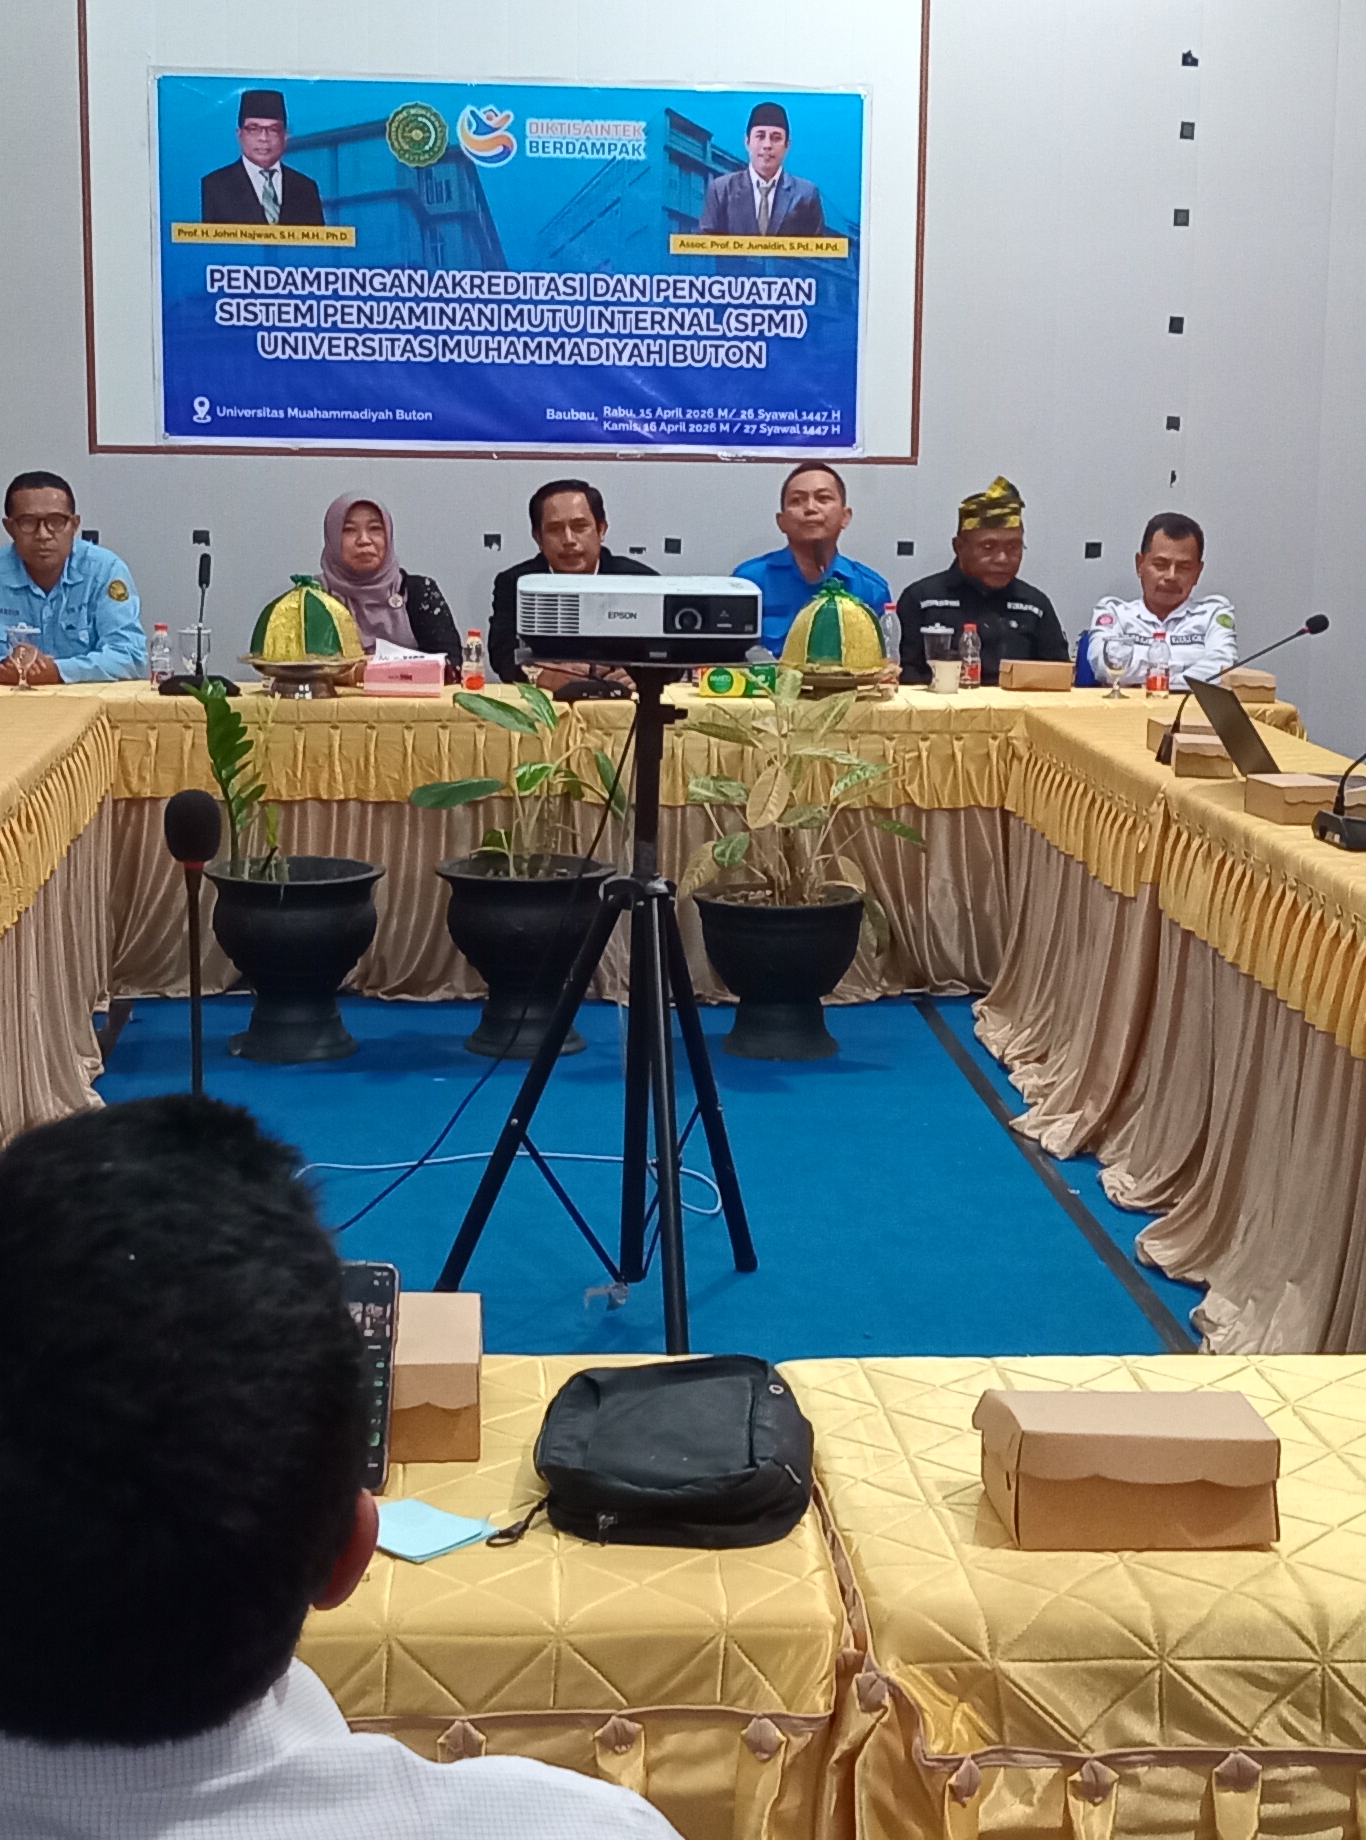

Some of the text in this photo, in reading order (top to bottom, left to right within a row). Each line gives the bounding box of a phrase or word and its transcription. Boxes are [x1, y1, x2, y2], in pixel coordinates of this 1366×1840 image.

[528, 121, 643, 138] DIKTISAINTEK
[529, 140, 643, 157] BERDAMPAK
[213, 230, 238, 238] Johni
[208, 268, 812, 303] PENDAMPINGAN AKREDITASI DAN PENGUATAN
[218, 301, 806, 335] SISTEM PENJAMINAN MUTU INTERNAL (SPMI)
[260, 333, 764, 367] UNIVERSITAS MUHAMMADIYAH BUTON
[216, 406, 433, 422] Universitas Muahammadiyah Buton
[546, 408, 598, 421] Baubau,
[603, 406, 636, 418] Rabu,
[639, 408, 652, 419] 15
[655, 407, 682, 419] April
[686, 407, 714, 418] 2026
[740, 409, 754, 419] 26
[758, 409, 798, 422] Syawal
[802, 411, 828, 421] 1447
[831, 410, 840, 421] H
[643, 421, 656, 432] 16
[659, 422, 686, 434] April
[689, 423, 716, 433] 2026
[719, 423, 730, 433] M
[744, 424, 757, 434] 27
[759, 424, 800, 436] Syawal
[803, 425, 829, 435] 1447
[831, 425, 840, 434] H
[608, 611, 637, 620] EPSON
